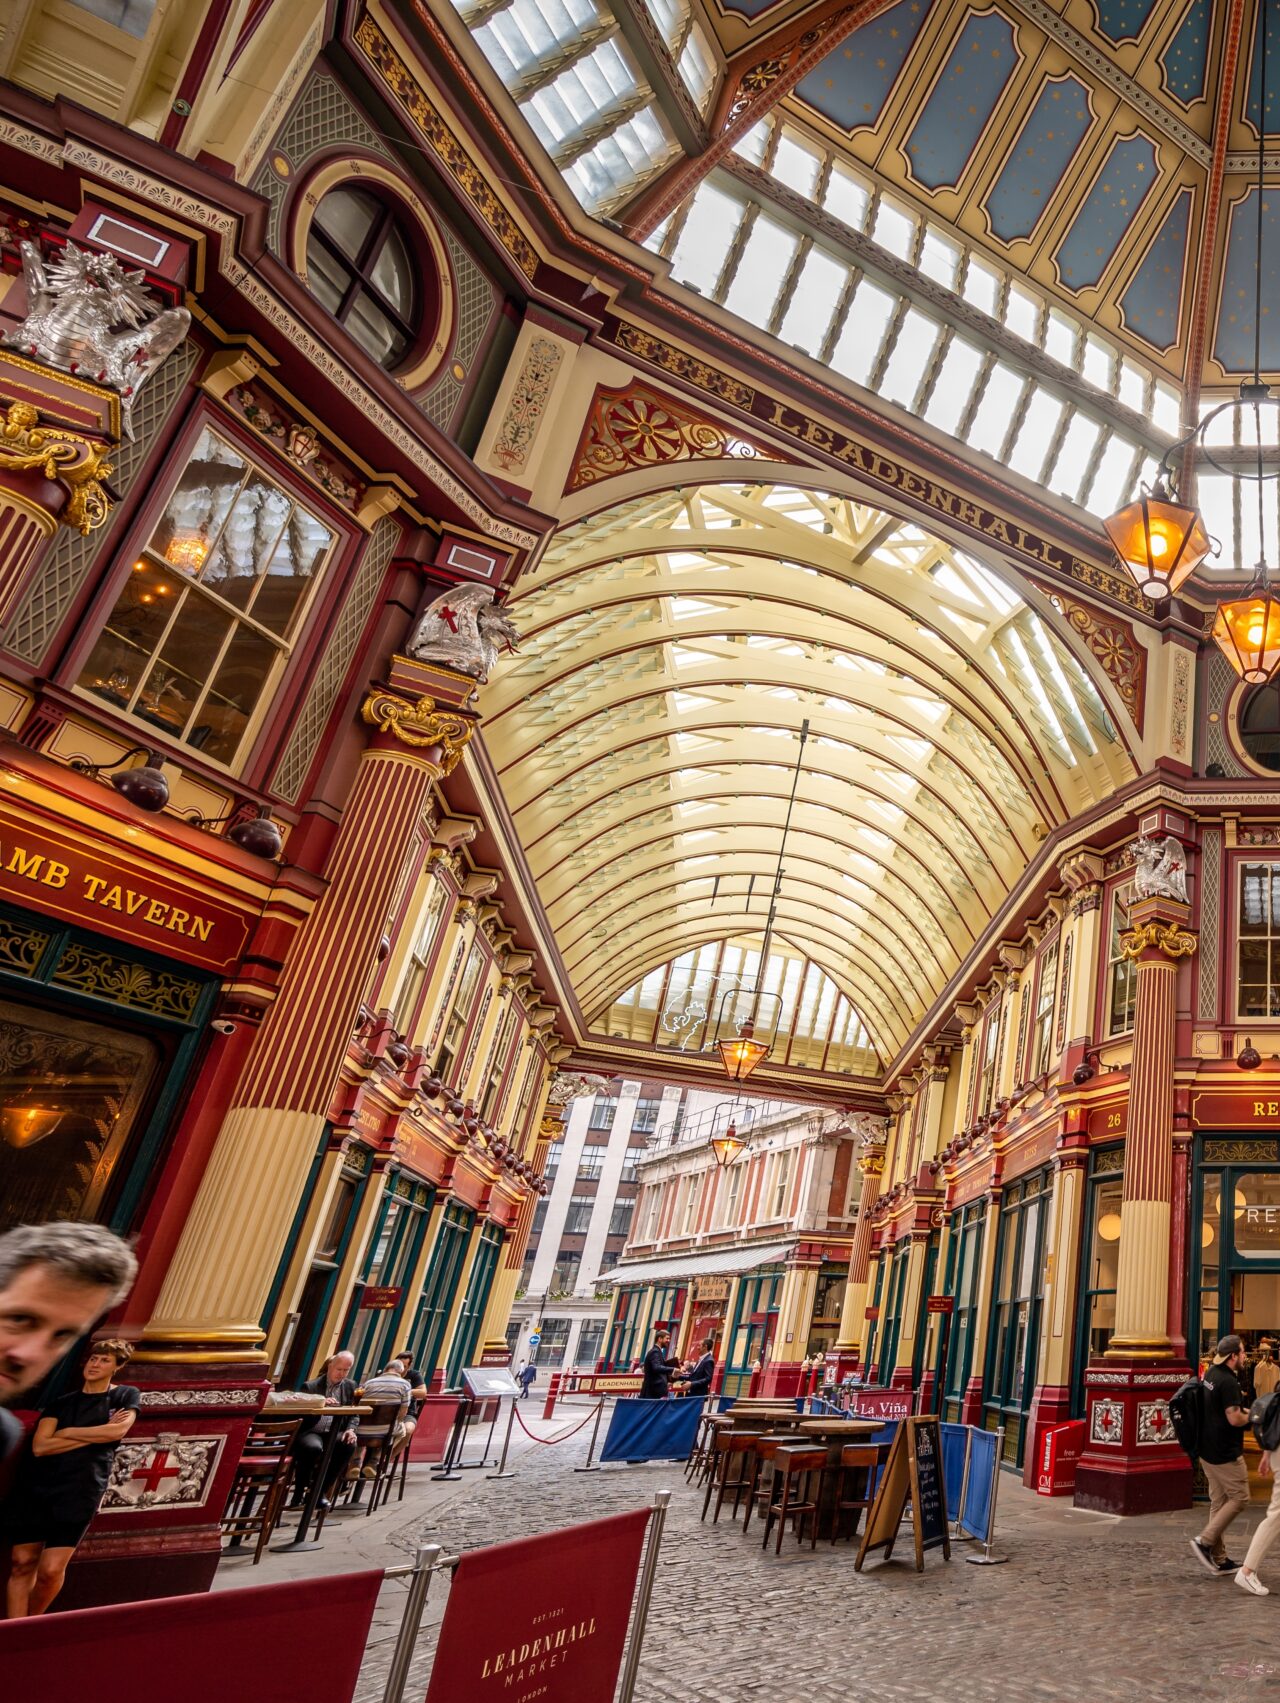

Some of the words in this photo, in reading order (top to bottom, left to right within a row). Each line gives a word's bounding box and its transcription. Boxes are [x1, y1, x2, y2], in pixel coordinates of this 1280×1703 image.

[0, 841, 70, 889] MB
[84, 874, 215, 942] TAVERN
[1107, 1113, 1121, 1128] 26
[860, 1403, 875, 1415] La
[880, 1402, 908, 1413] Viña
[481, 1617, 597, 1679] LEADENHALL
[504, 1650, 568, 1688] MARKET
[517, 1685, 548, 1703] LONDON
